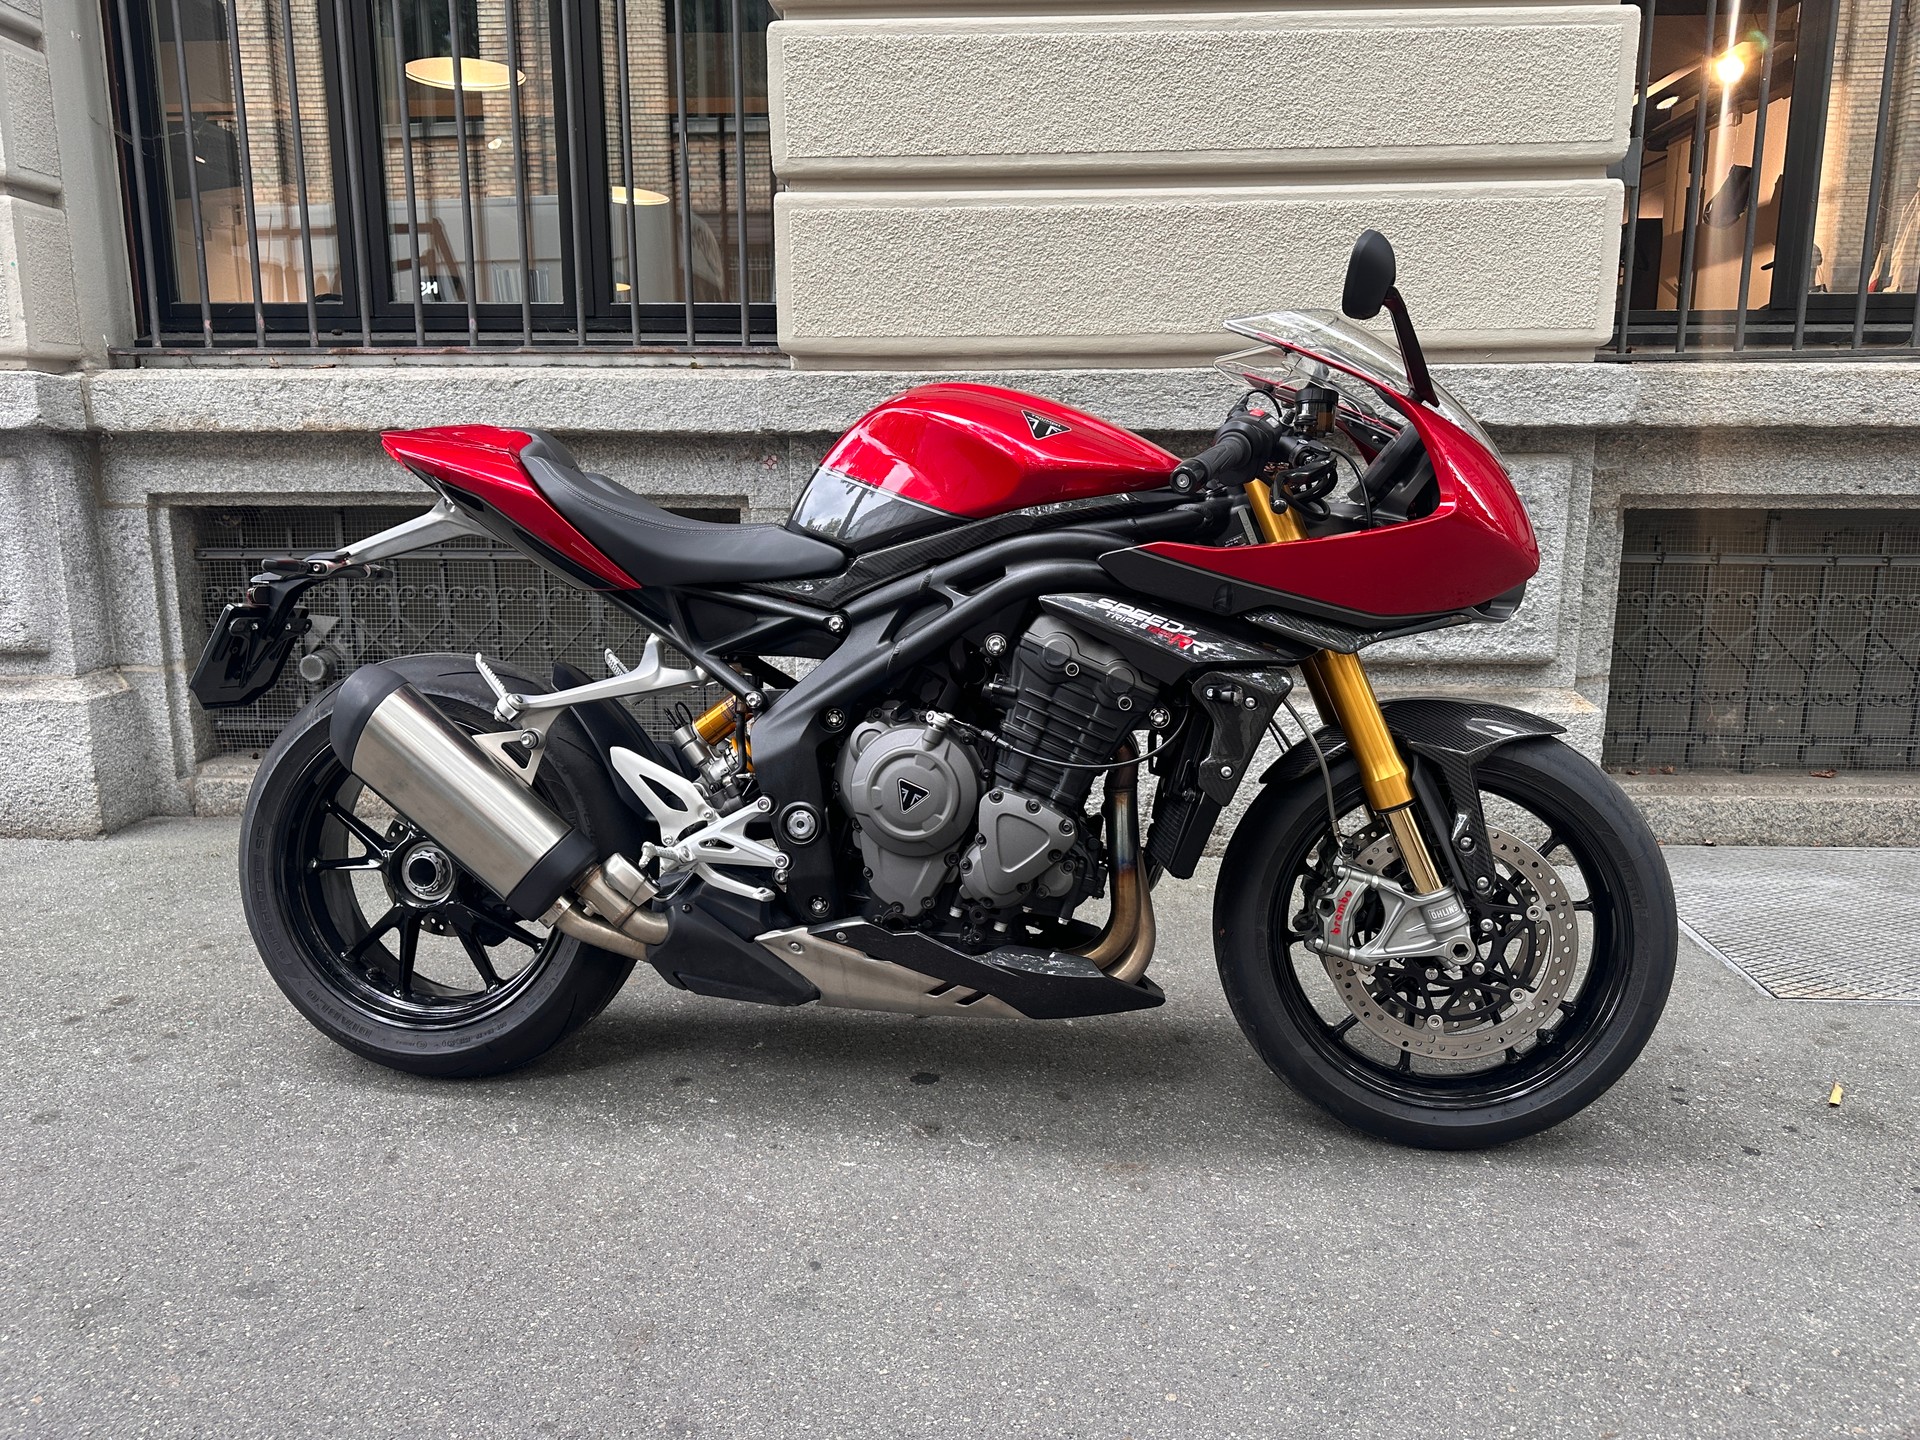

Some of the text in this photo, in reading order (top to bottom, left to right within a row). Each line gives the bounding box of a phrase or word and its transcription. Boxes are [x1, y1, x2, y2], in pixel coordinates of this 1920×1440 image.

[1097, 598, 1185, 634] SPEED
[1104, 610, 1150, 630] TRIPLE
[1168, 632, 1209, 655] RR
[1330, 890, 1353, 935] brembo
